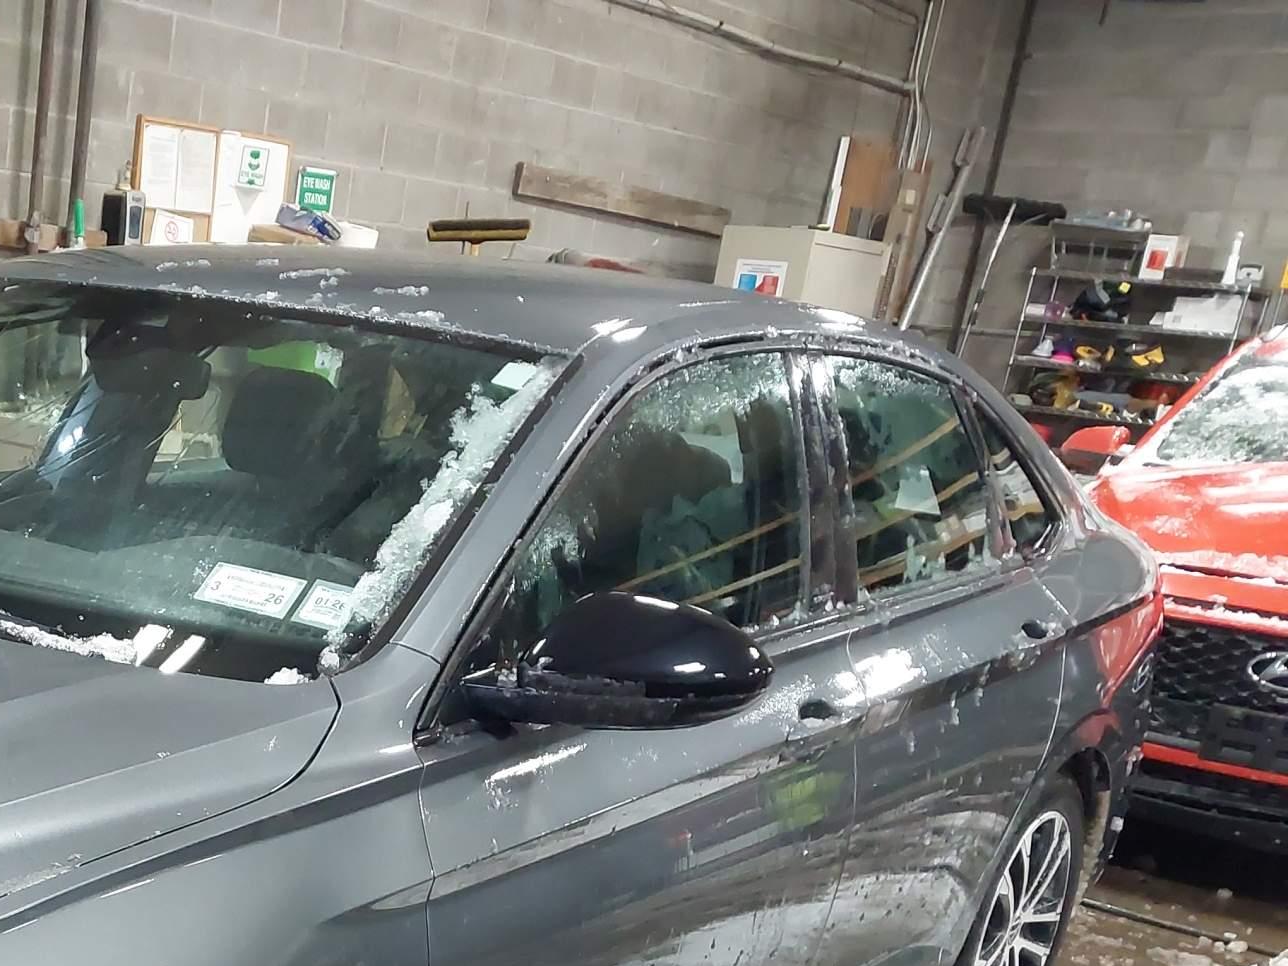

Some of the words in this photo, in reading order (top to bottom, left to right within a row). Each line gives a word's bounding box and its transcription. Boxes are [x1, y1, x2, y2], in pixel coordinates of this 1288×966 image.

[303, 176, 315, 189] EYE
[314, 177, 331, 190] WASH
[303, 191, 328, 206] STATION
[263, 592, 285, 605] 26
